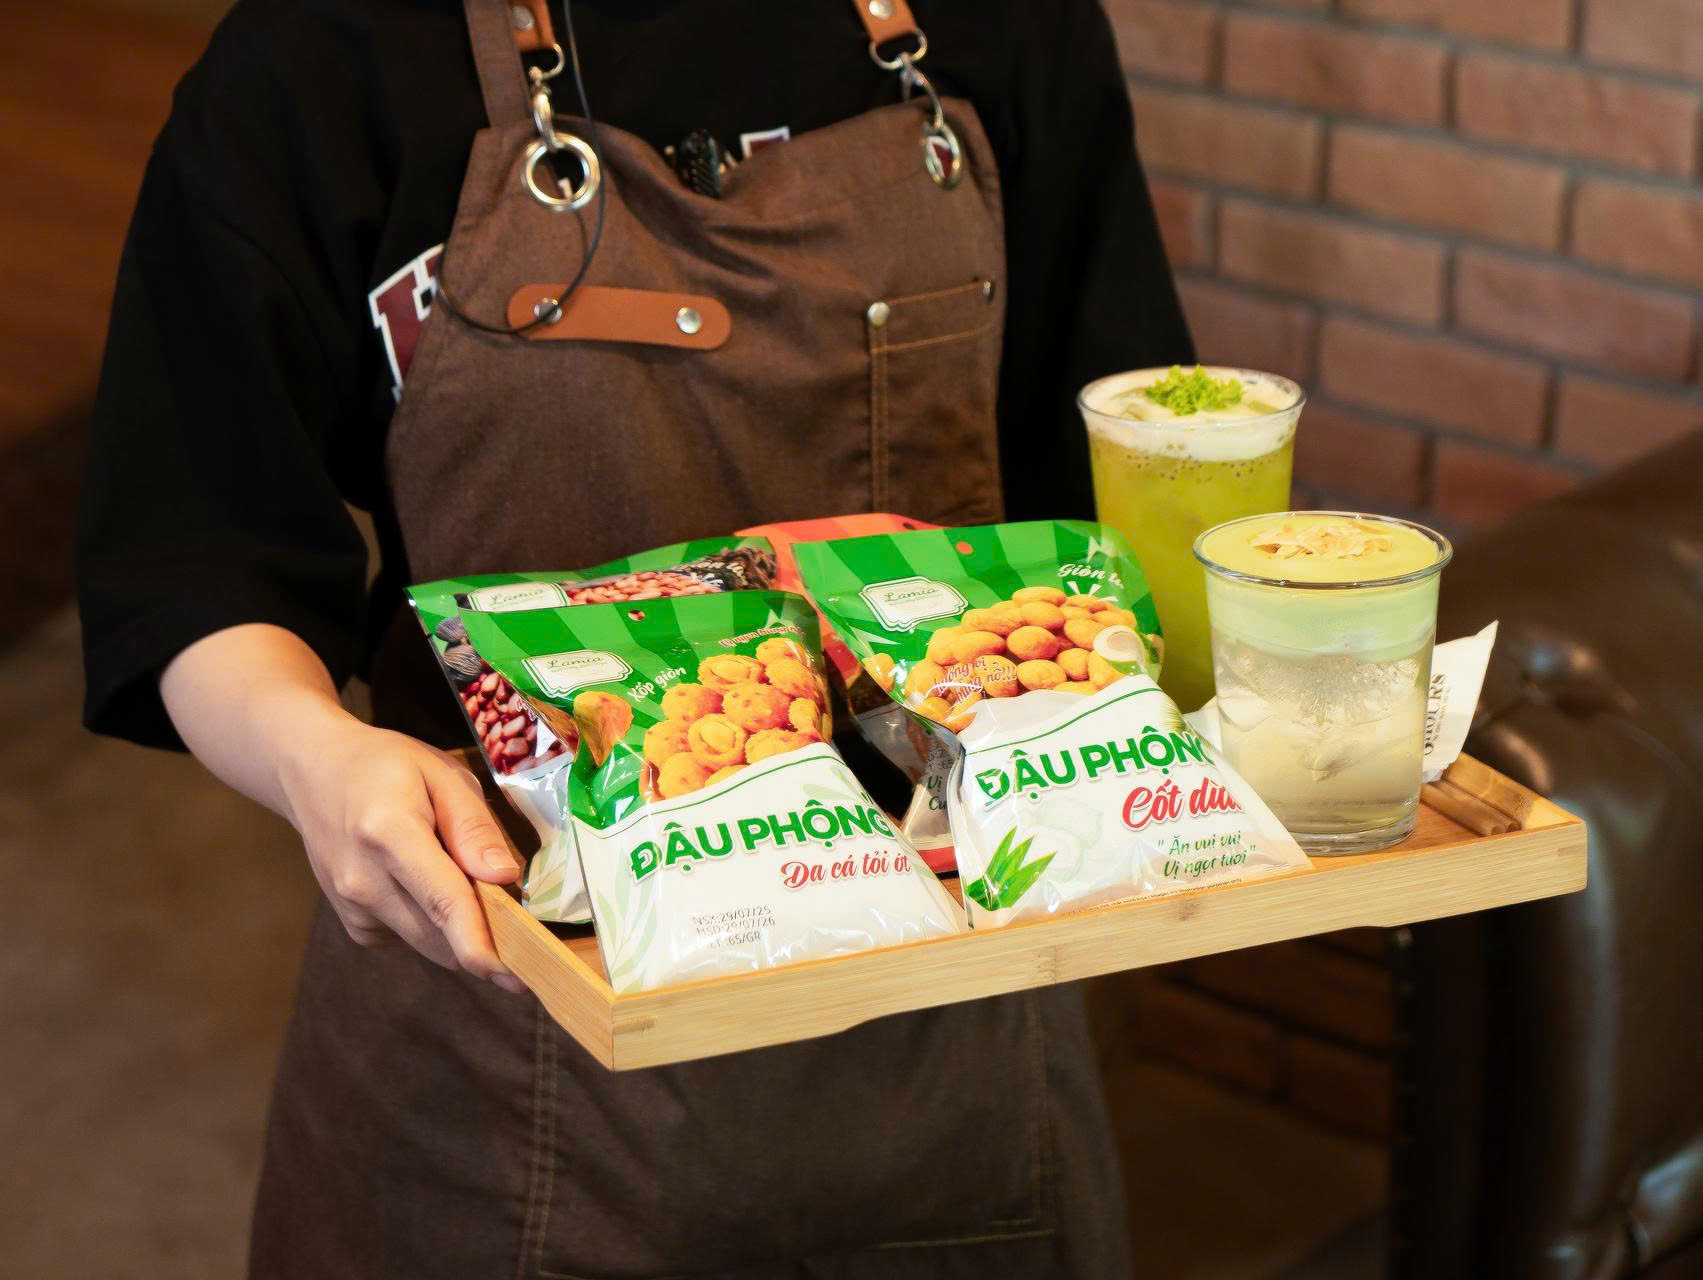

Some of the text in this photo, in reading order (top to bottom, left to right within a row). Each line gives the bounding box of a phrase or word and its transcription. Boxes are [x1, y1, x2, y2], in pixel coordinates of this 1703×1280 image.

[655, 666, 687, 689] giòn
[976, 748, 1076, 808] ĐẬU
[1122, 779, 1183, 829] Cốt
[630, 799, 896, 880] ĐẬU PHỘNG
[781, 859, 825, 889] Da
[831, 854, 857, 880] cá
[863, 849, 889, 875] tỏi
